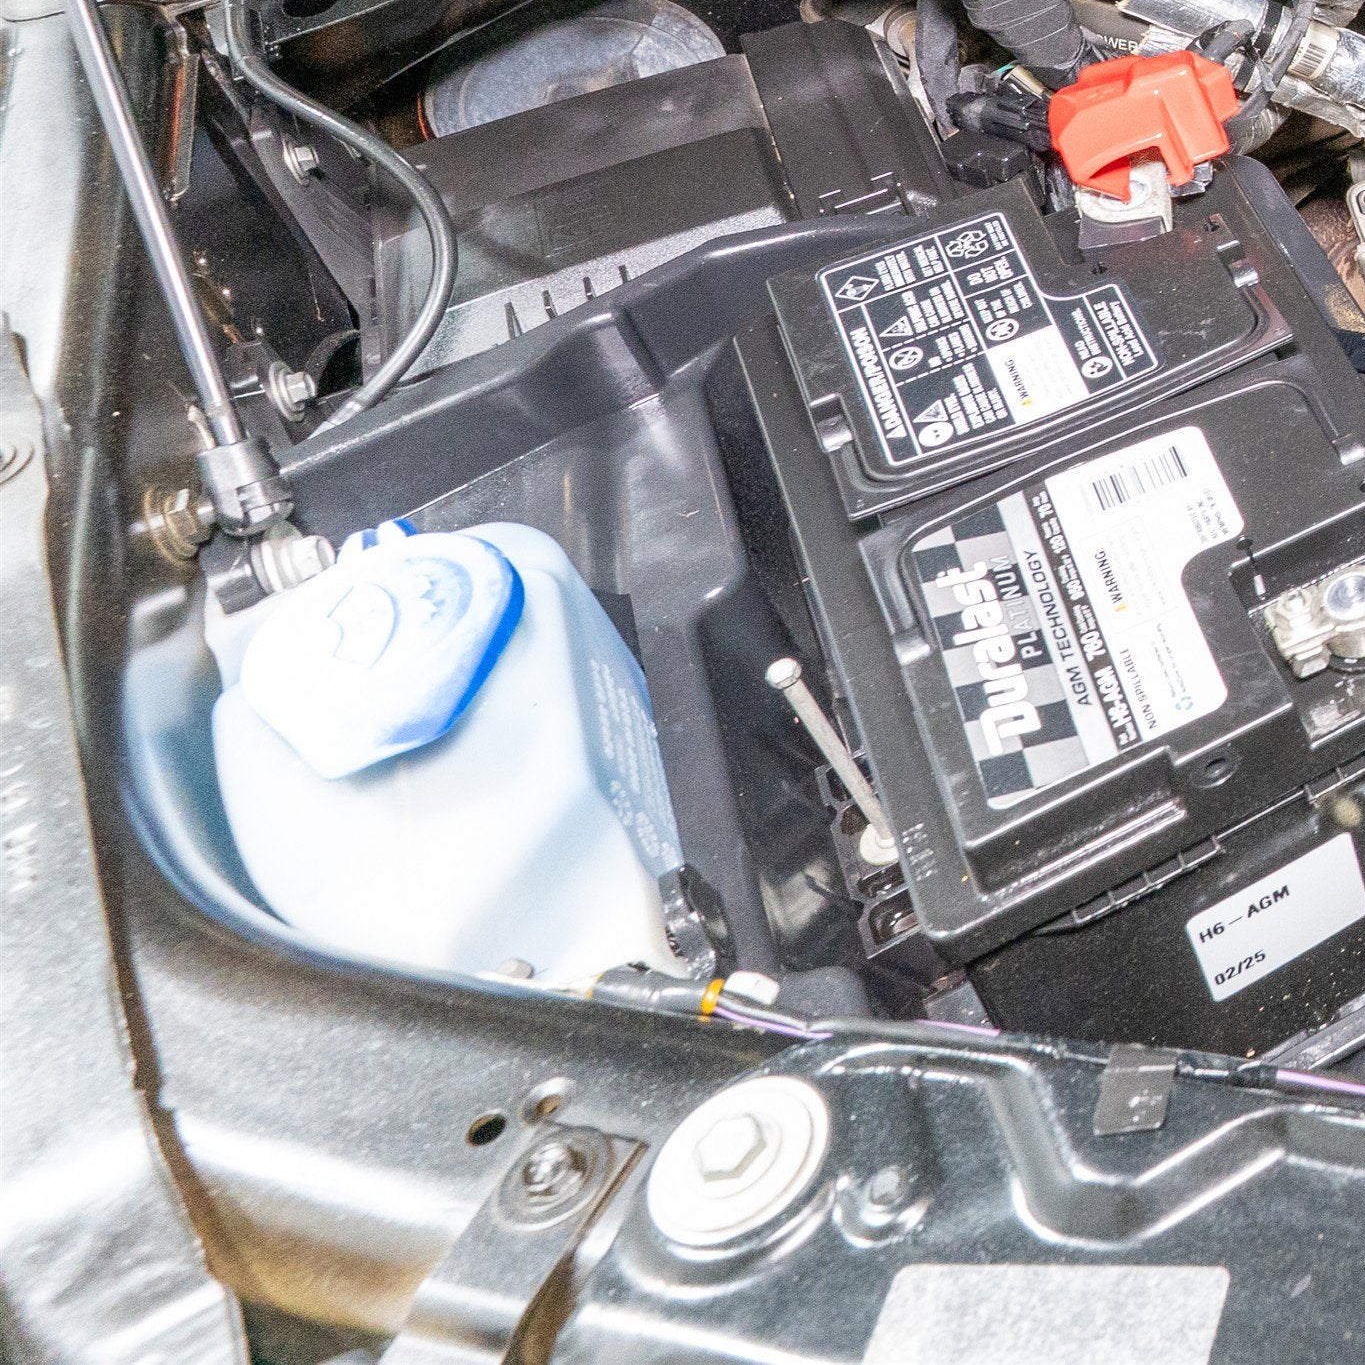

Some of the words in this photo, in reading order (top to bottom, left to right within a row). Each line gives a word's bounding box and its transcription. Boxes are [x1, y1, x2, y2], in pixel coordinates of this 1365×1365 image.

[966, 272, 983, 285] DO
[980, 266, 998, 283] NOT
[993, 256, 1013, 279] OPEN.
[1074, 340, 1090, 359] READ
[1093, 301, 1134, 365] NON-SPILLABLE
[851, 327, 901, 428] DANGER/POISON
[1005, 359, 1028, 398] WARNING
[1037, 503, 1053, 518] 70
[1049, 534, 1066, 553] 120
[1094, 550, 1122, 602] WARNING:
[989, 550, 1043, 662] PLATINUM
[1025, 551, 1072, 660] TECHNOLOGY
[934, 557, 1044, 758] Duralast
[1080, 631, 1105, 661] 760
[1066, 666, 1090, 704] AGM
[1120, 648, 1146, 703] SPILLABLE
[1094, 666, 1130, 727] H6-AGM
[1142, 704, 1156, 729] NON
[1198, 921, 1225, 944] H6
[1246, 885, 1290, 919] AGM
[1214, 949, 1267, 986] 02/25
